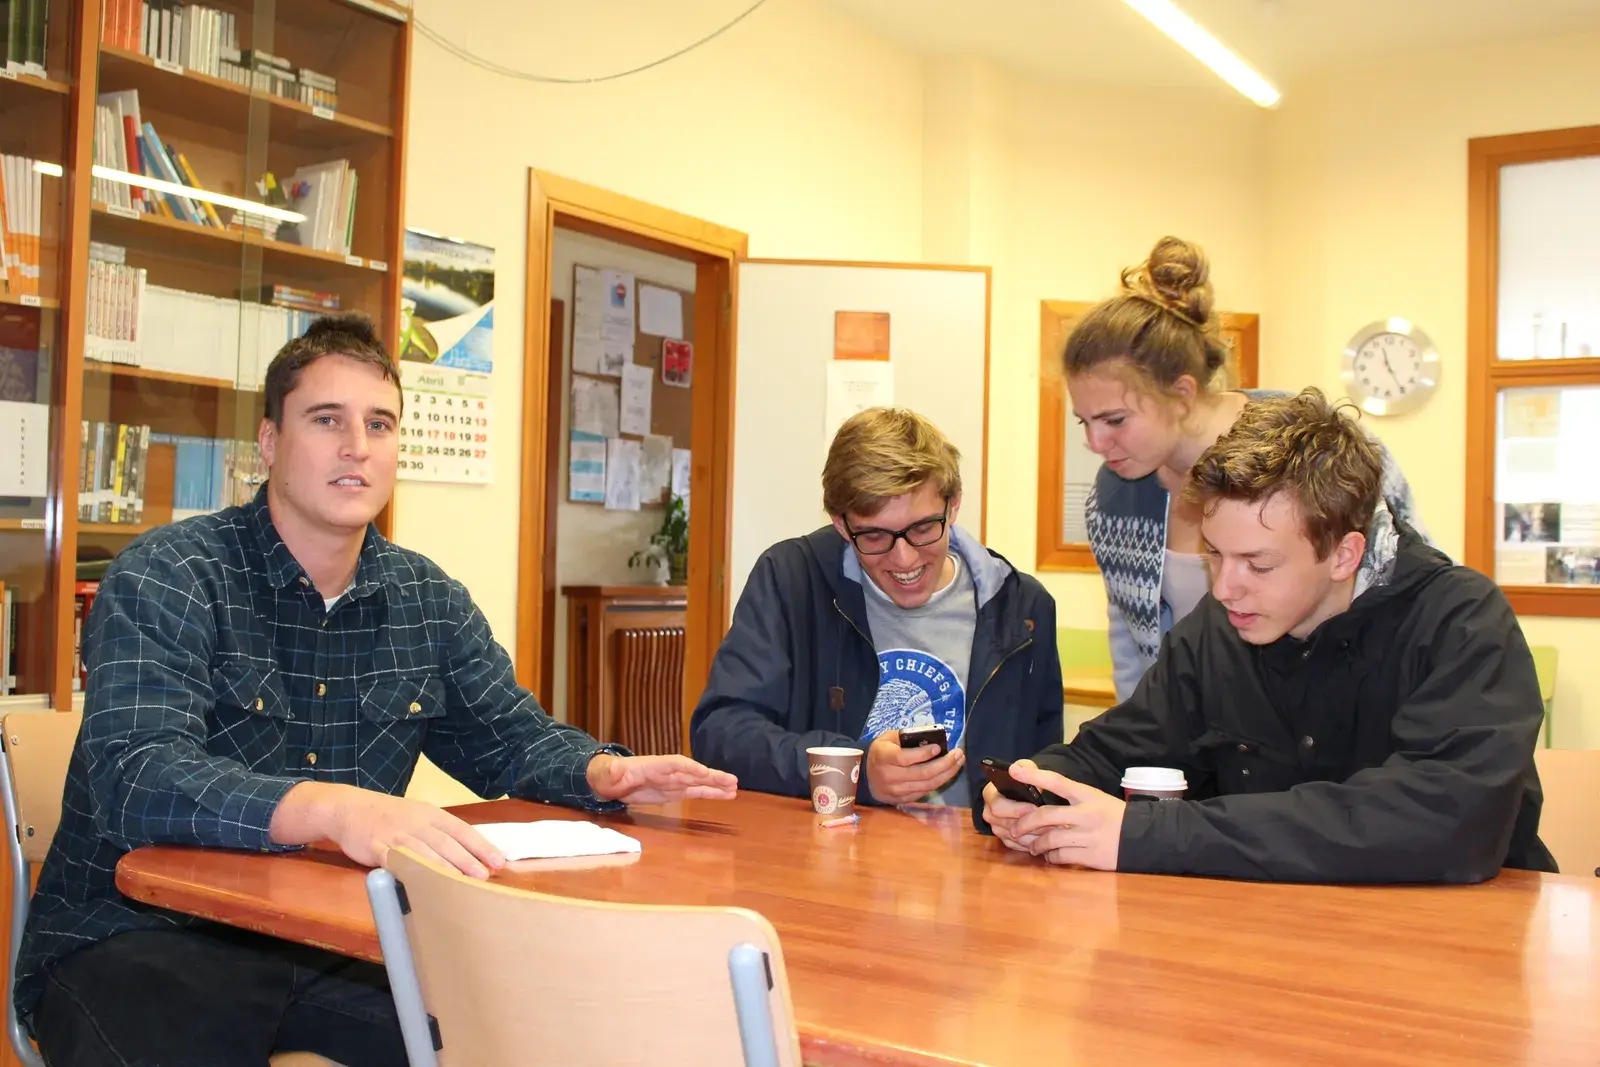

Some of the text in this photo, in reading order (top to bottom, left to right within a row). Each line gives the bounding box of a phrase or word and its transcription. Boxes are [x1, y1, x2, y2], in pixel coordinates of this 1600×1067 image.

[418, 376, 444, 386] Abril
[414, 394, 420, 402] 2
[430, 396, 436, 404] 3
[446, 398, 452, 406] 4
[462, 400, 468, 408] 5
[414, 411, 486, 426] 9 10 11 12 13
[411, 428, 423, 437] 16
[428, 430, 440, 438] 17
[460, 432, 471, 441] 19
[474, 433, 486, 442] 20
[427, 446, 439, 455] 24
[444, 448, 455, 456] 25
[460, 448, 471, 458] 26
[474, 450, 486, 458] 27
[411, 461, 424, 470] 30
[896, 658, 950, 692] CHIEFS
